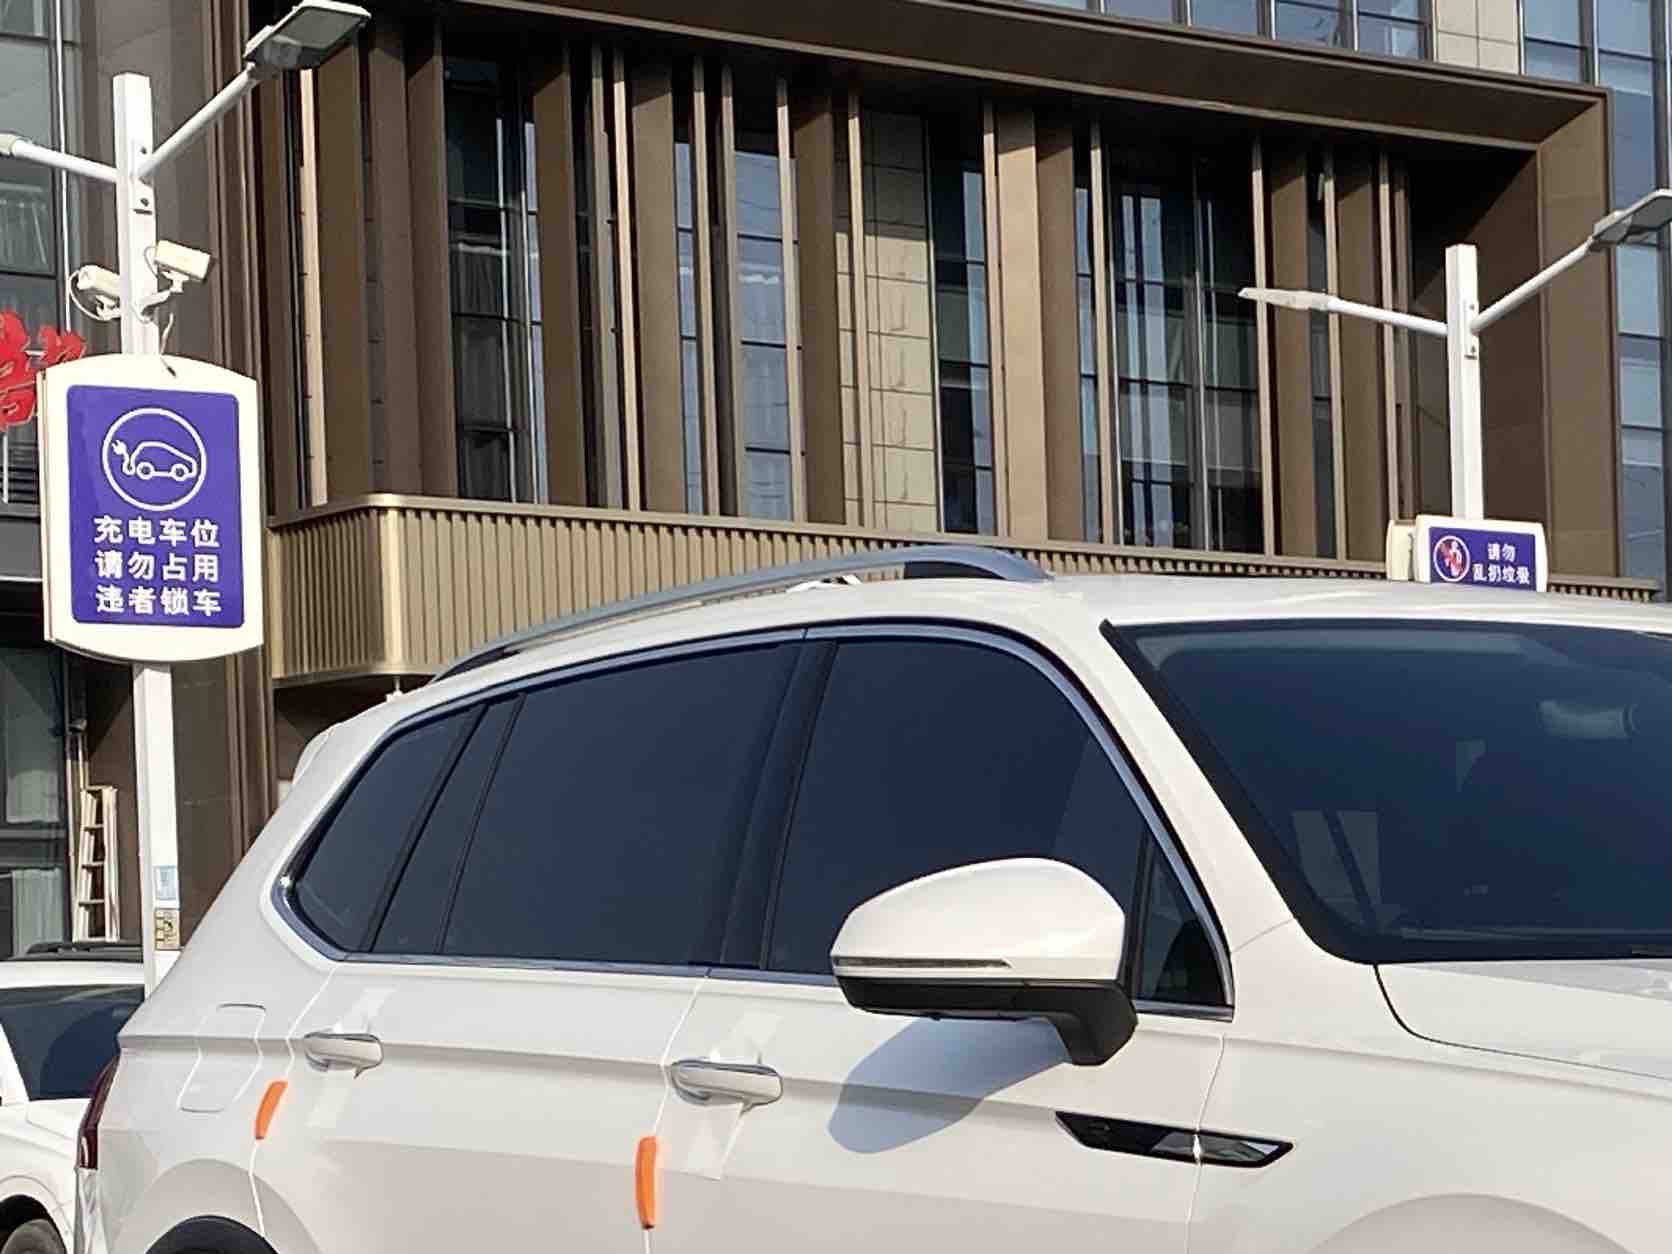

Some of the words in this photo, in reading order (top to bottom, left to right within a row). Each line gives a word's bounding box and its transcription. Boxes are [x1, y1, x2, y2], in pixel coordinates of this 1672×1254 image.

[93, 515, 220, 549] 充电车位
[94, 550, 219, 583] 请勿占用
[1487, 543, 1516, 562] 请勿
[1472, 563, 1531, 585] 乱扔垃圾
[96, 585, 221, 616] 违者锁车
